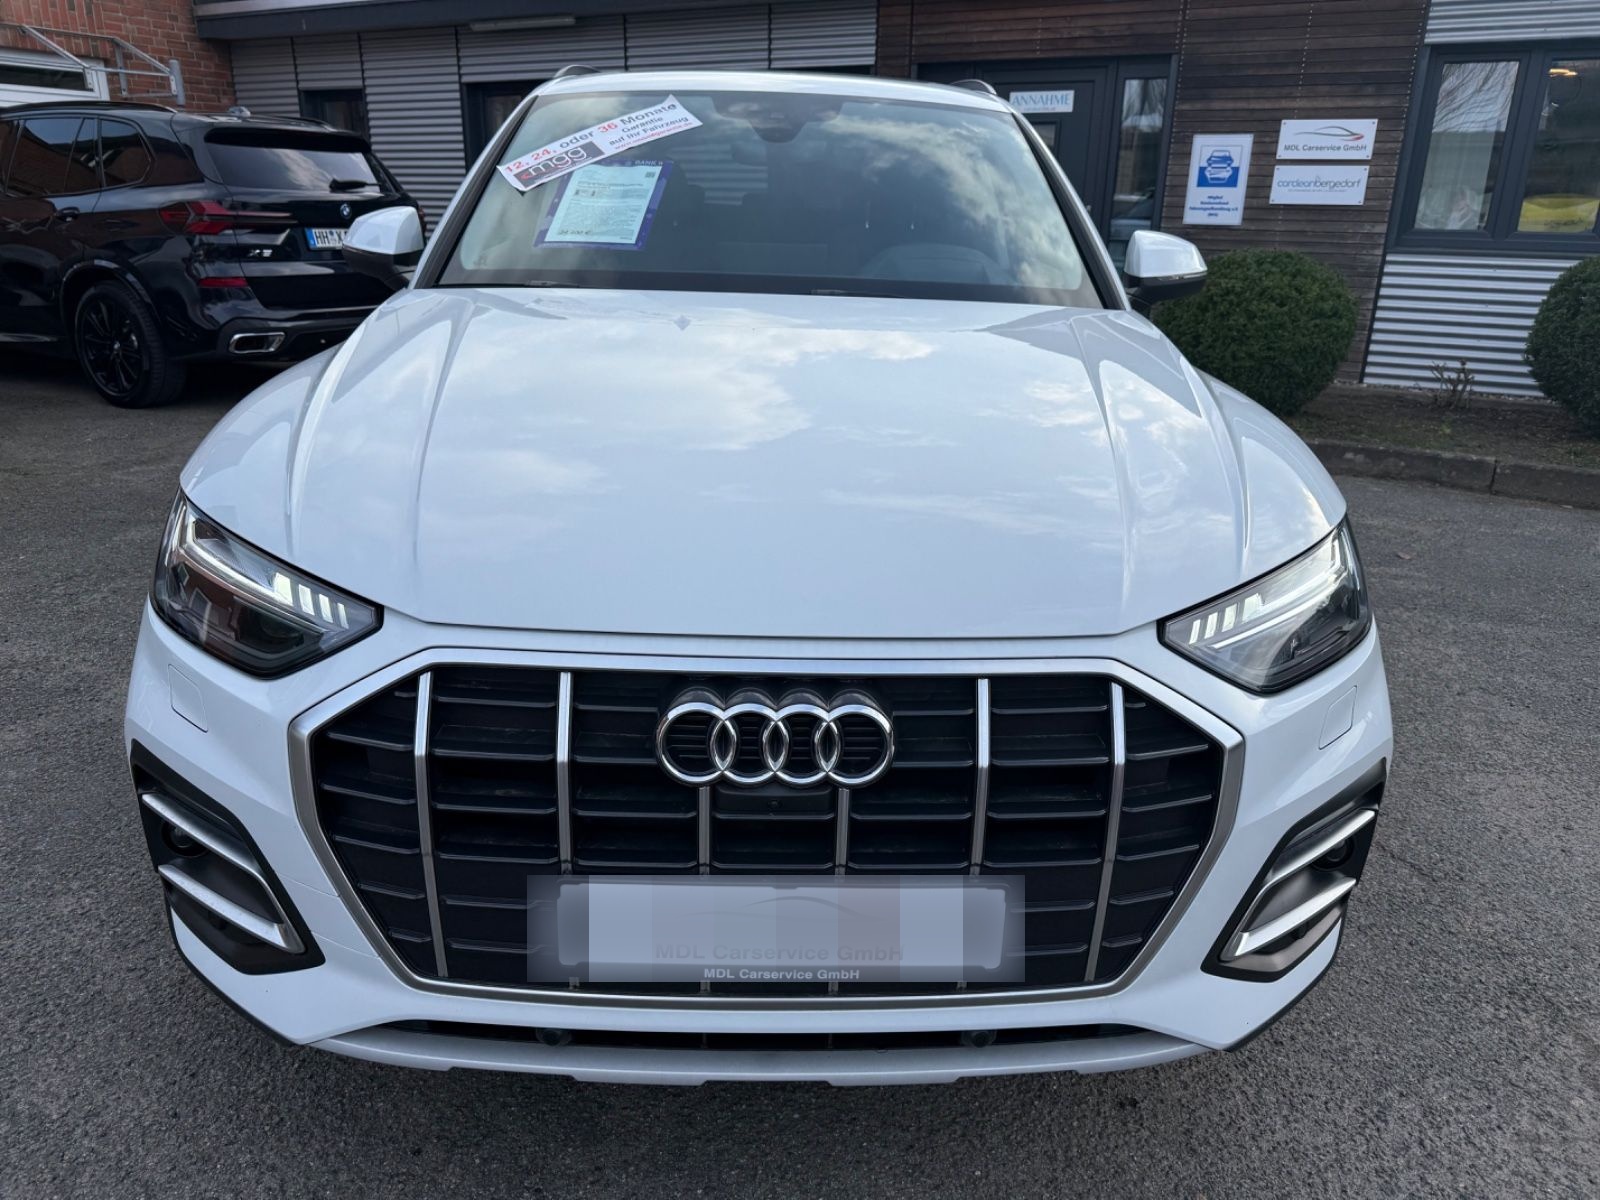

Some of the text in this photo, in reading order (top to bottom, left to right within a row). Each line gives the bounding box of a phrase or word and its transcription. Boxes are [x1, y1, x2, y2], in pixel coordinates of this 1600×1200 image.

[560, 130, 594, 149] oder
[597, 122, 618, 134] 36
[620, 103, 677, 126] Monate
[609, 135, 625, 146] auf
[642, 116, 689, 134] Fahrzeug
[1283, 143, 1367, 153] MDL Carservice GmbH
[528, 146, 587, 177] mgg
[314, 229, 331, 246] HH
[655, 944, 905, 962] MDL Carservice GmbH
[703, 967, 861, 980] MDL Carservice GmbH
